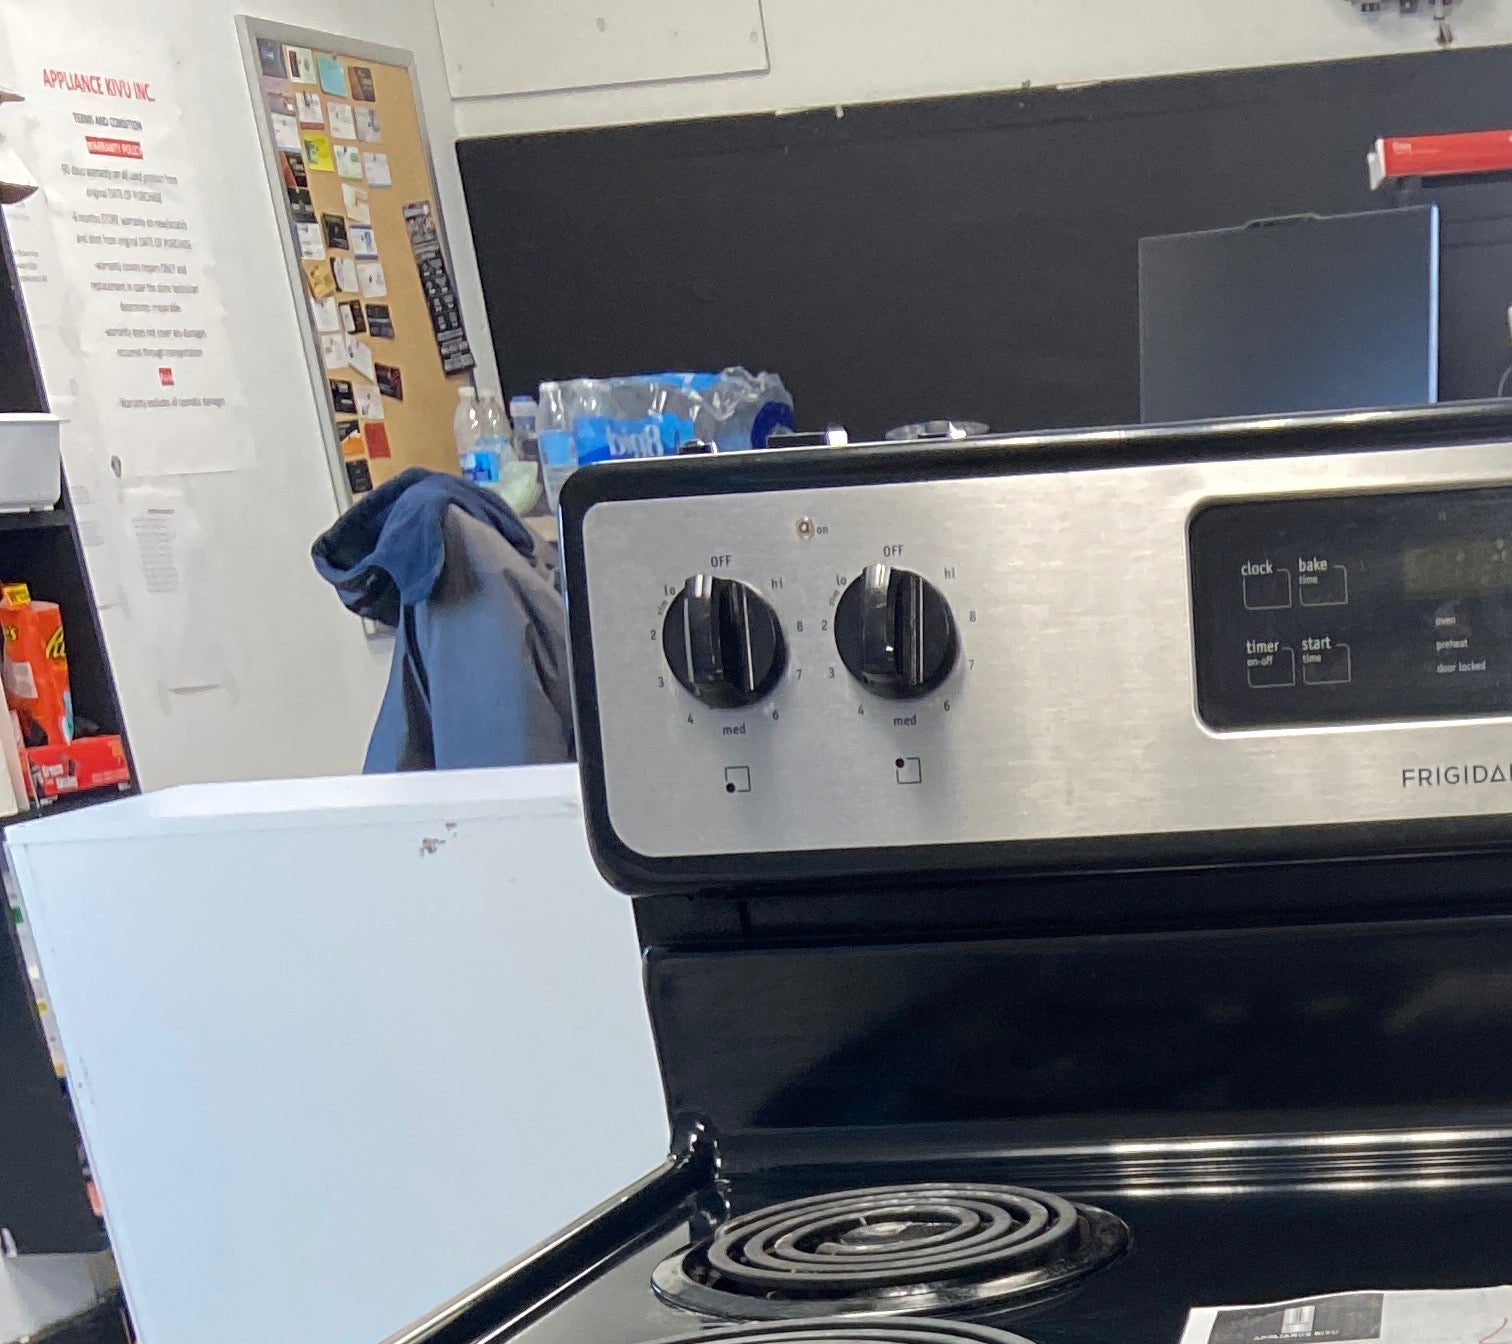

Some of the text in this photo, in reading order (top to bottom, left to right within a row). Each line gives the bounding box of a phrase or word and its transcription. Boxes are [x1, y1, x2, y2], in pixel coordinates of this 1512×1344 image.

[43, 68, 104, 96] APPLIANCE
[105, 77, 132, 99] KIVU
[816, 526, 829, 535] on
[883, 544, 904, 557] OFF
[710, 555, 732, 568] OFF
[1241, 559, 1273, 576] clock
[1298, 556, 1328, 572] bake
[944, 567, 956, 580] hi
[771, 577, 783, 590] hi
[836, 574, 847, 586] lo
[664, 585, 676, 597] lo
[969, 611, 976, 622] 8
[797, 621, 804, 632] 8
[821, 620, 828, 631] 2
[650, 630, 657, 641] 2
[1246, 639, 1279, 654] timer
[1302, 636, 1332, 651] start
[968, 659, 975, 671] 7
[1247, 655, 1273, 666] on-off
[1302, 654, 1322, 664] time
[829, 667, 835, 678] 3
[1437, 663, 1457, 673] door
[796, 669, 803, 680] 7
[658, 677, 665, 688] 3
[858, 705, 864, 716] 4
[943, 701, 950, 712] 6
[687, 712, 694, 724] 4
[772, 711, 779, 721] 6
[893, 715, 917, 727] med
[722, 723, 746, 736] med
